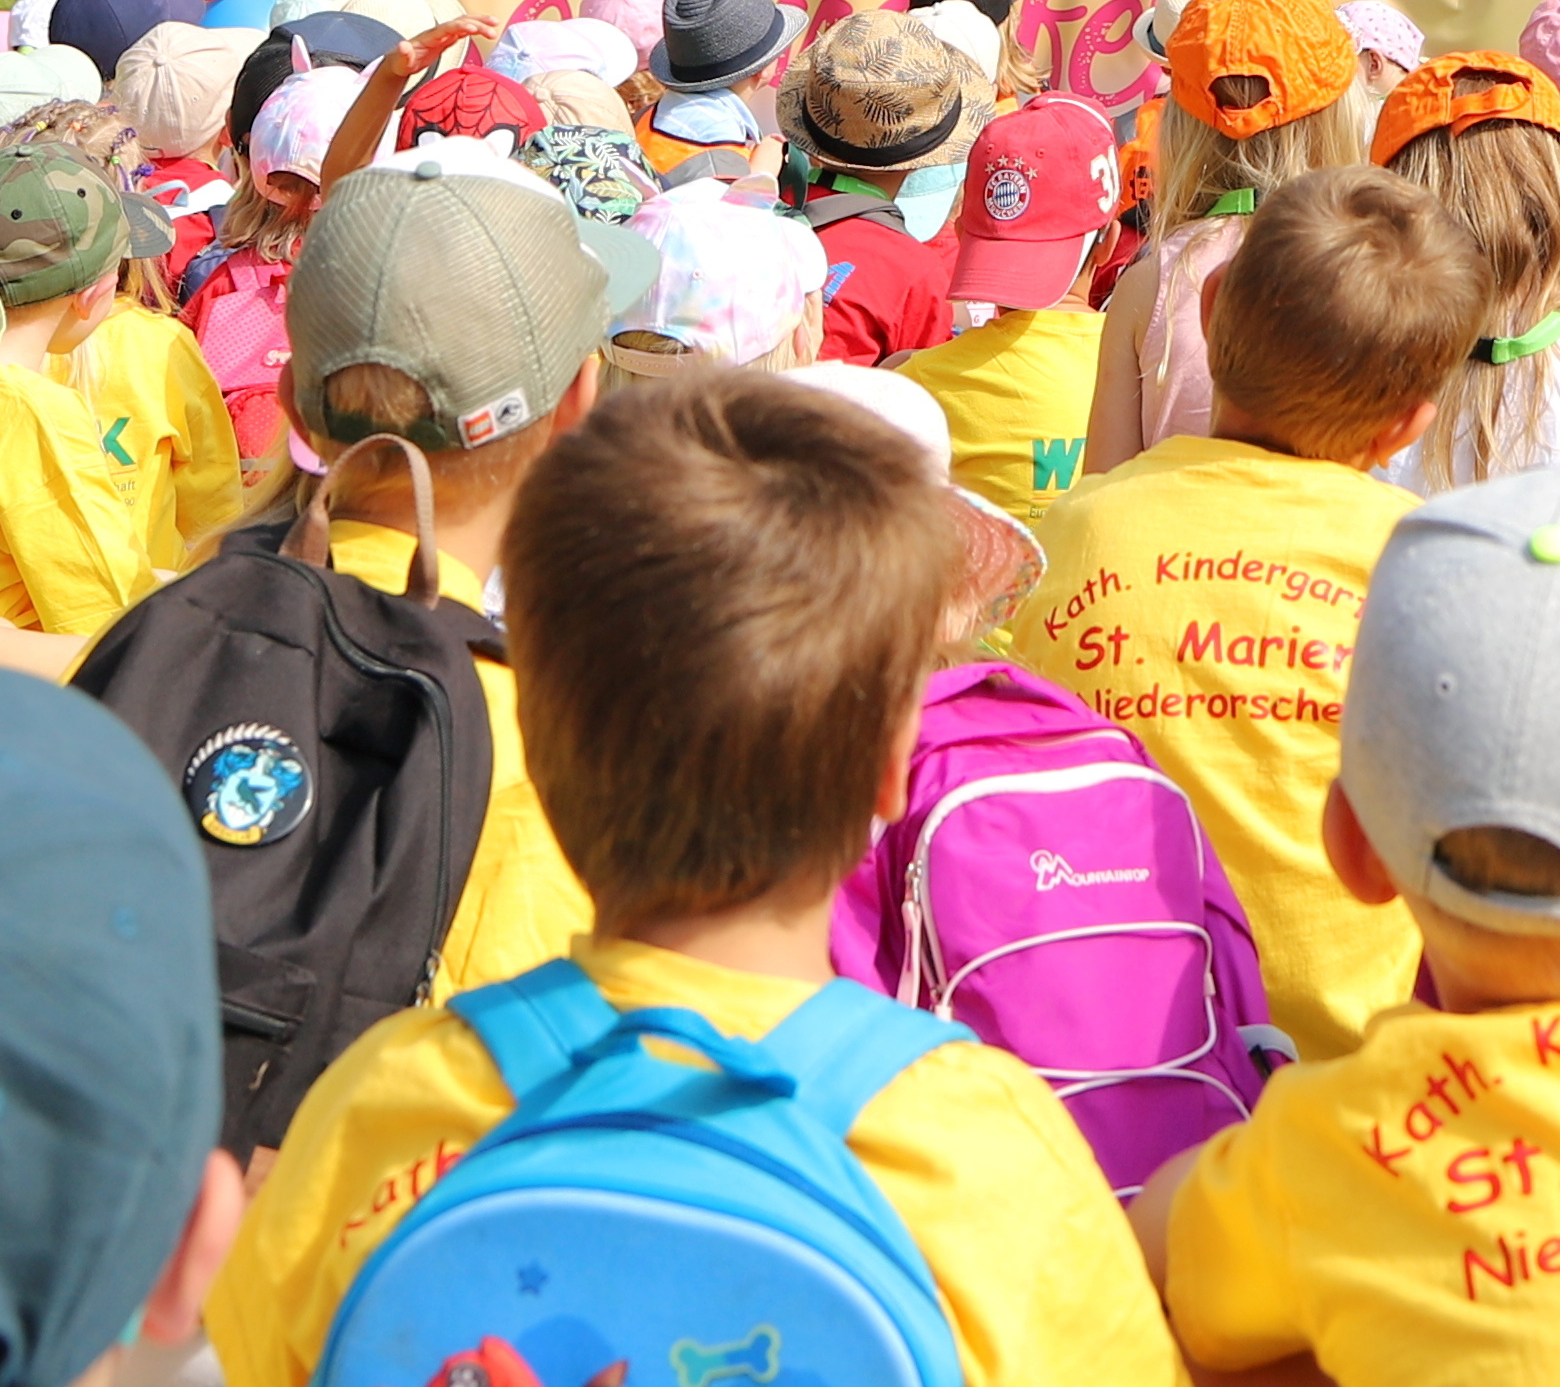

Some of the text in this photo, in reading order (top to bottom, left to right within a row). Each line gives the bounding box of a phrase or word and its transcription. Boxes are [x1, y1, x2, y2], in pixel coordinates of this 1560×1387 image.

[997, 172, 1027, 193] BAYERN
[1043, 567, 1132, 641] Kath.
[1076, 625, 1145, 671] St.
[1363, 1054, 1502, 1178] Kath.
